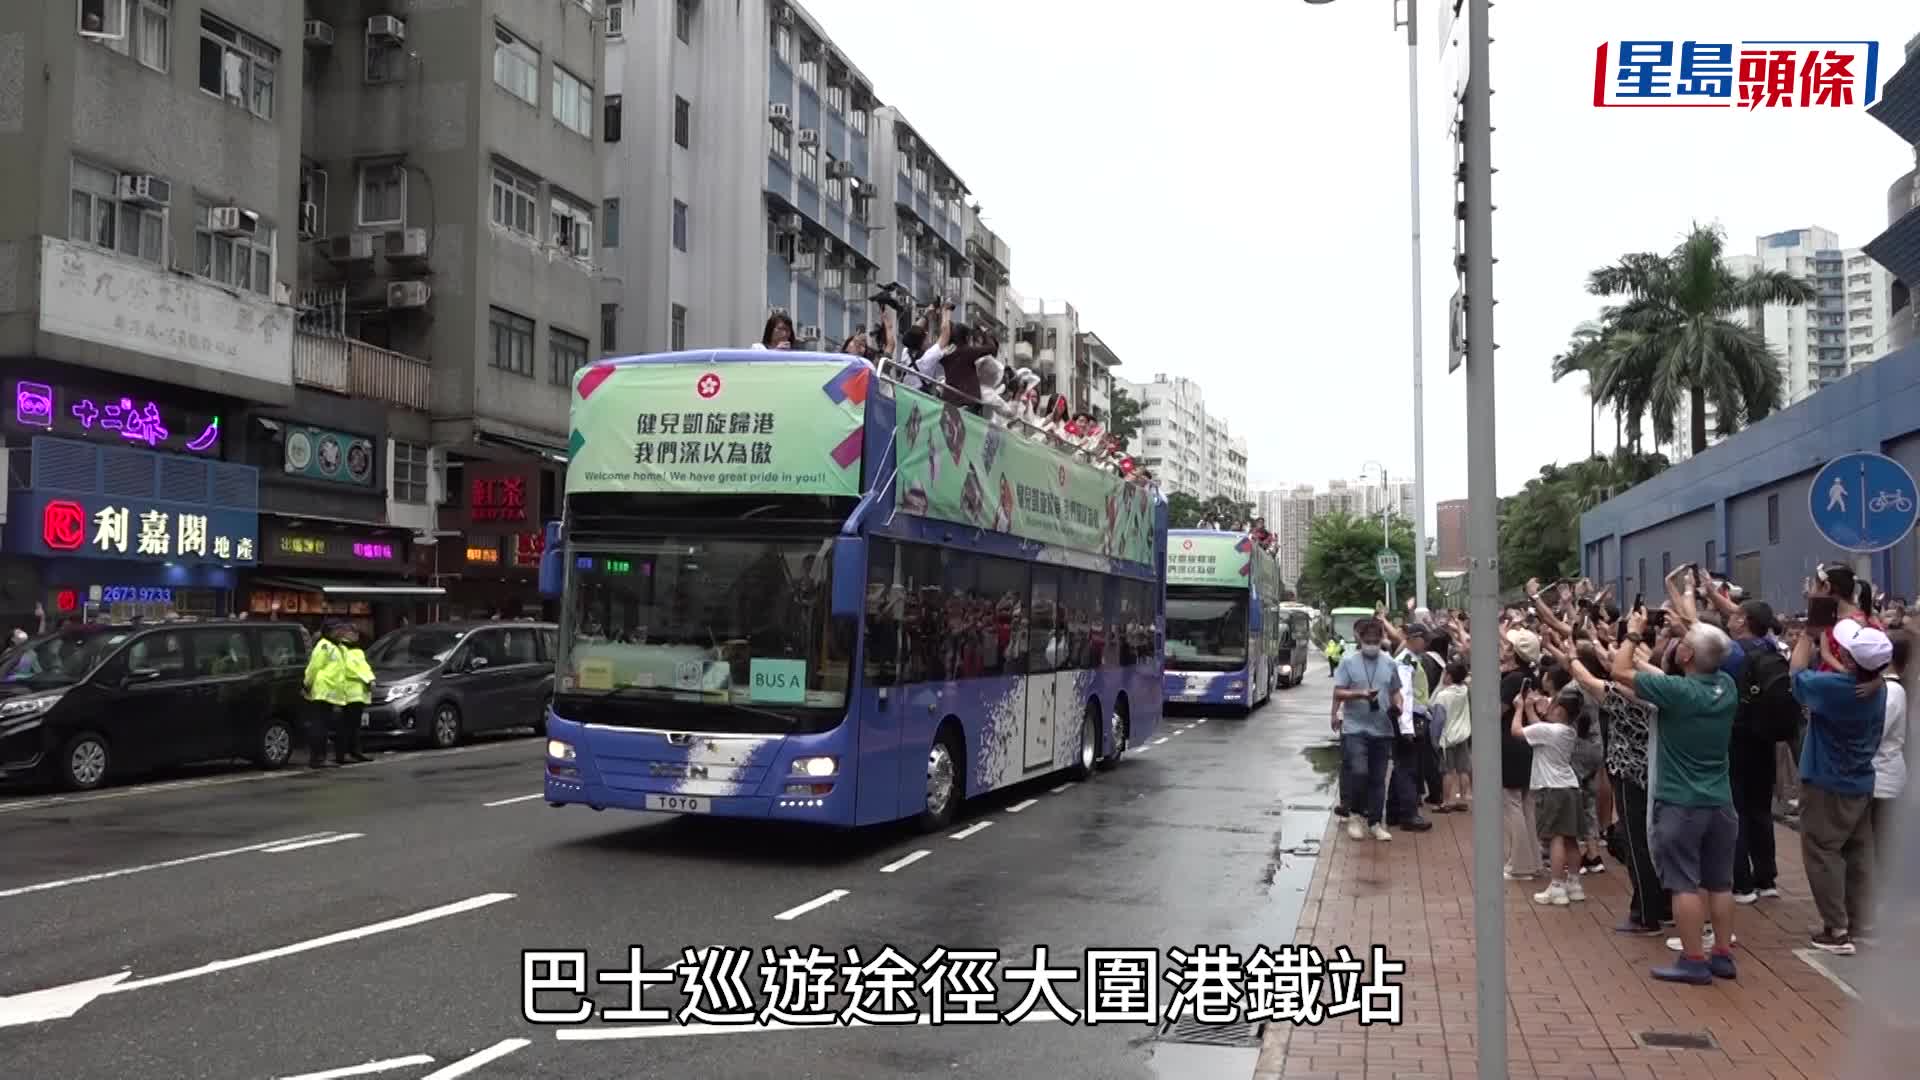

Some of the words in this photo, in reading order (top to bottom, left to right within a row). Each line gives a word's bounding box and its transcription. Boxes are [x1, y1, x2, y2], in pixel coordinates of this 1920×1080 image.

[637, 413, 775, 435] 健兒凱旋歸港
[635, 441, 772, 464] 我們深以為傲
[584, 471, 631, 482] Welcome
[669, 472, 689, 483] We
[690, 472, 717, 483] have
[718, 472, 748, 484] great
[750, 472, 780, 484] pride
[782, 473, 793, 483] in
[104, 585, 136, 601] 2673
[755, 672, 784, 690] BUS
[789, 673, 800, 690] A
[658, 797, 699, 811] TOYO
